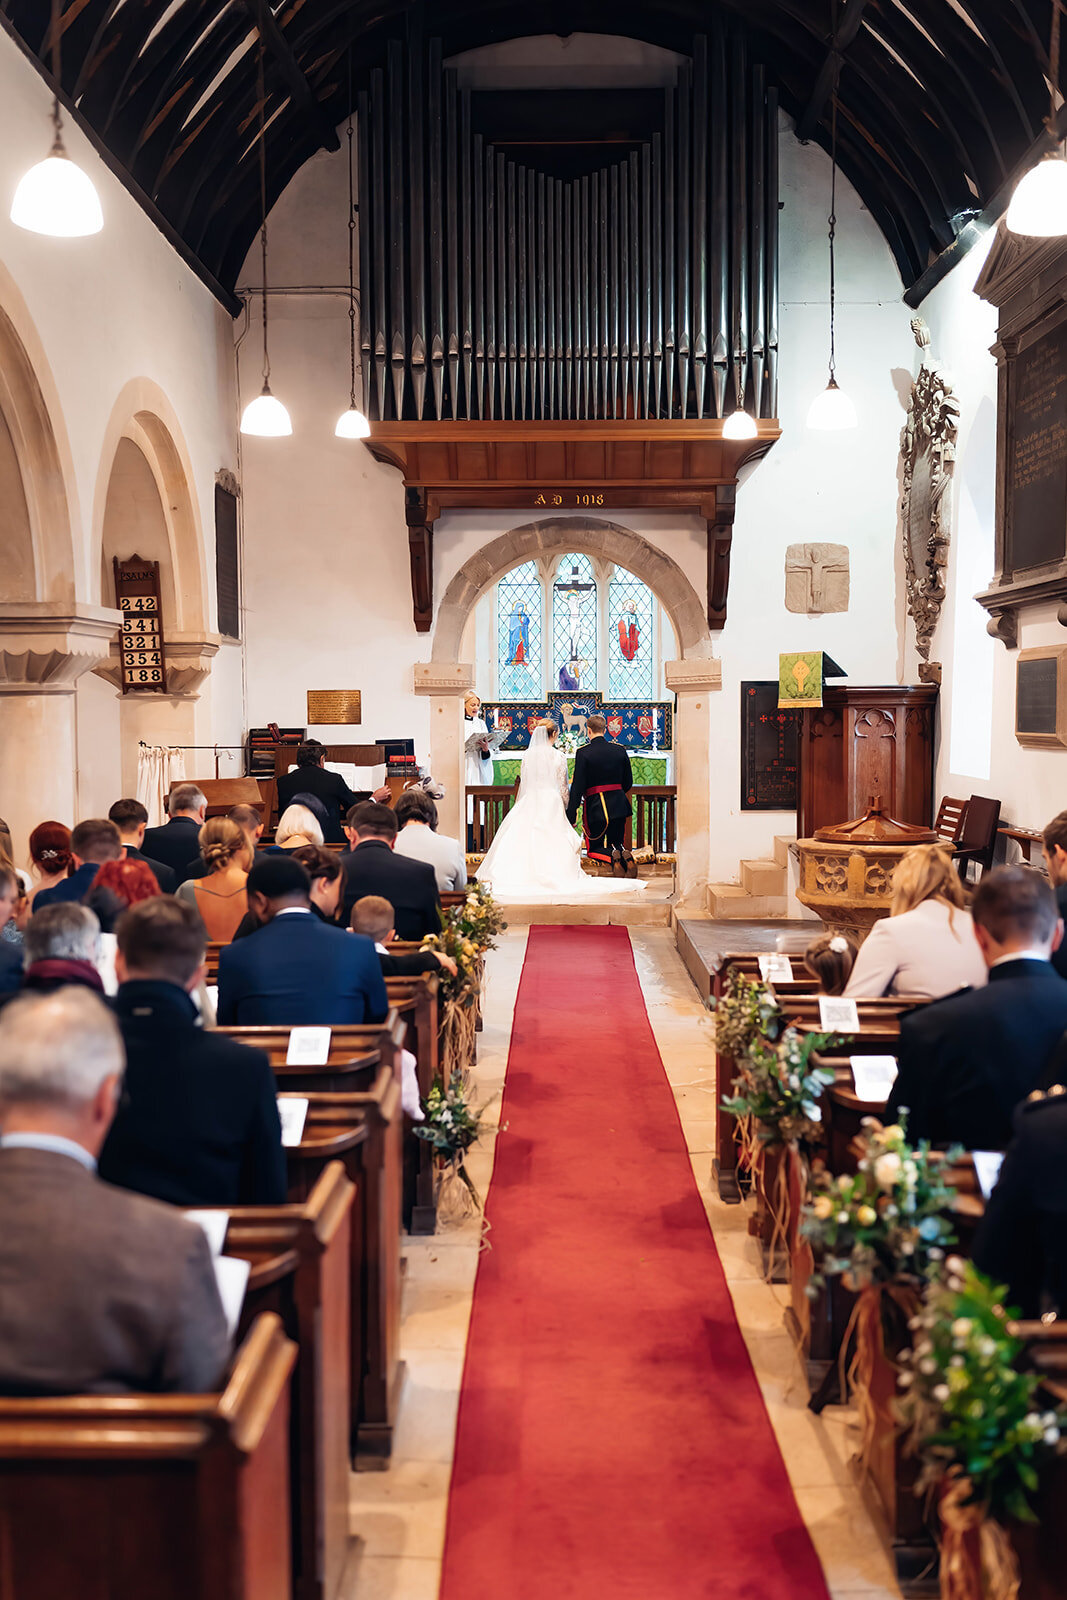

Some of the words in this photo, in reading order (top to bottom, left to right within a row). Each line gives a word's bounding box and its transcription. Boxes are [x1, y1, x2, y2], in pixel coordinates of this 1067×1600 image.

[534, 494, 546, 505] A
[551, 494, 562, 505] D
[576, 494, 604, 505] 1918
[120, 571, 155, 581] PSALMS
[121, 598, 155, 610] 242
[123, 619, 156, 632] 541
[124, 636, 157, 649] 321
[125, 653, 160, 665] 354
[127, 670, 161, 682] 188
